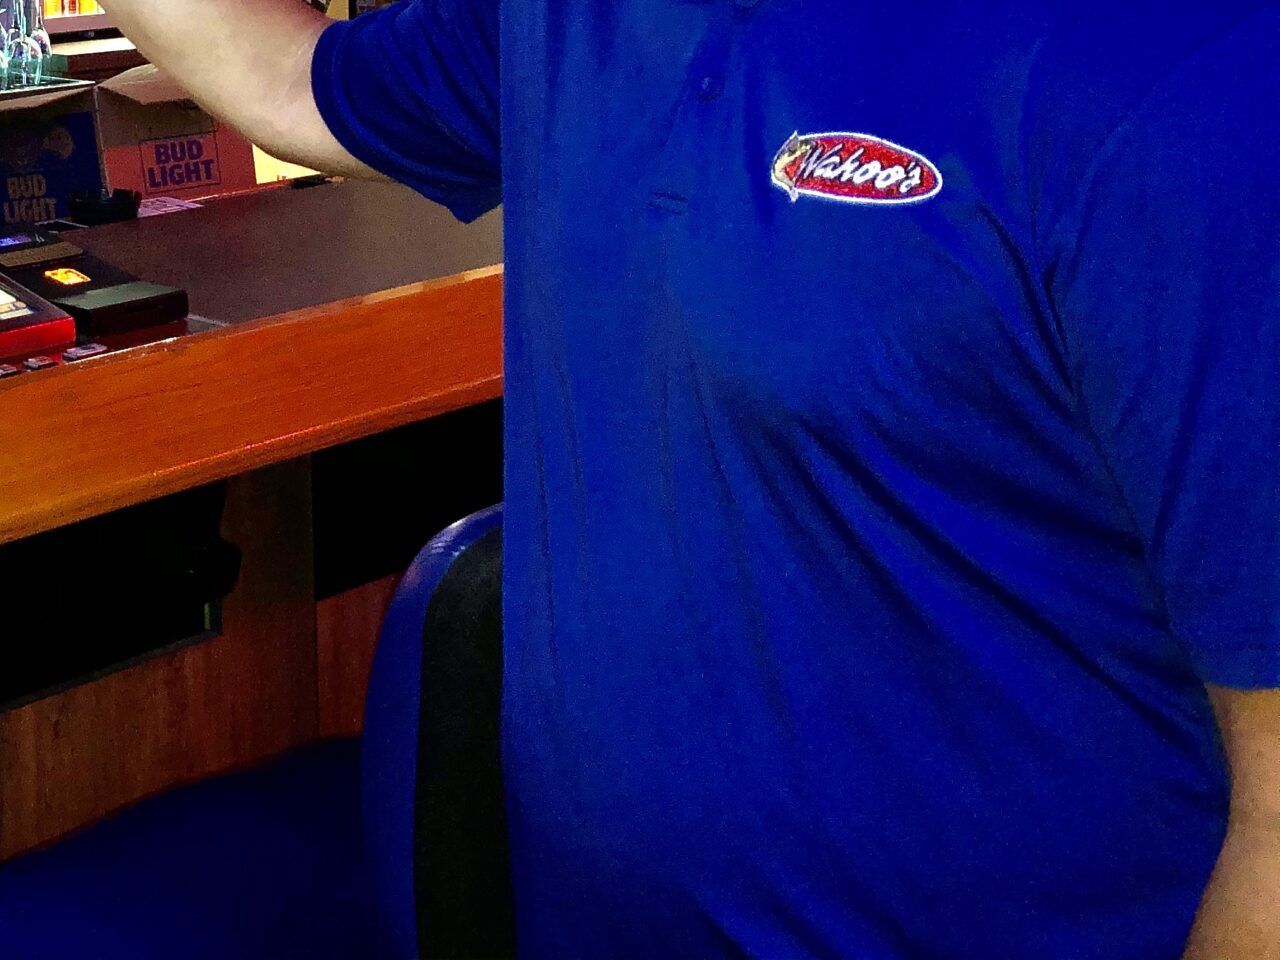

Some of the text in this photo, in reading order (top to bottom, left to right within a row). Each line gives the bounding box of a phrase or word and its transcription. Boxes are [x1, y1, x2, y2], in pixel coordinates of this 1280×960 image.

[154, 139, 204, 166] BUD
[147, 159, 215, 189] LIGHT
[794, 143, 922, 194] Wahoo's
[7, 174, 47, 198] BUD
[3, 197, 58, 224] LIGHT
